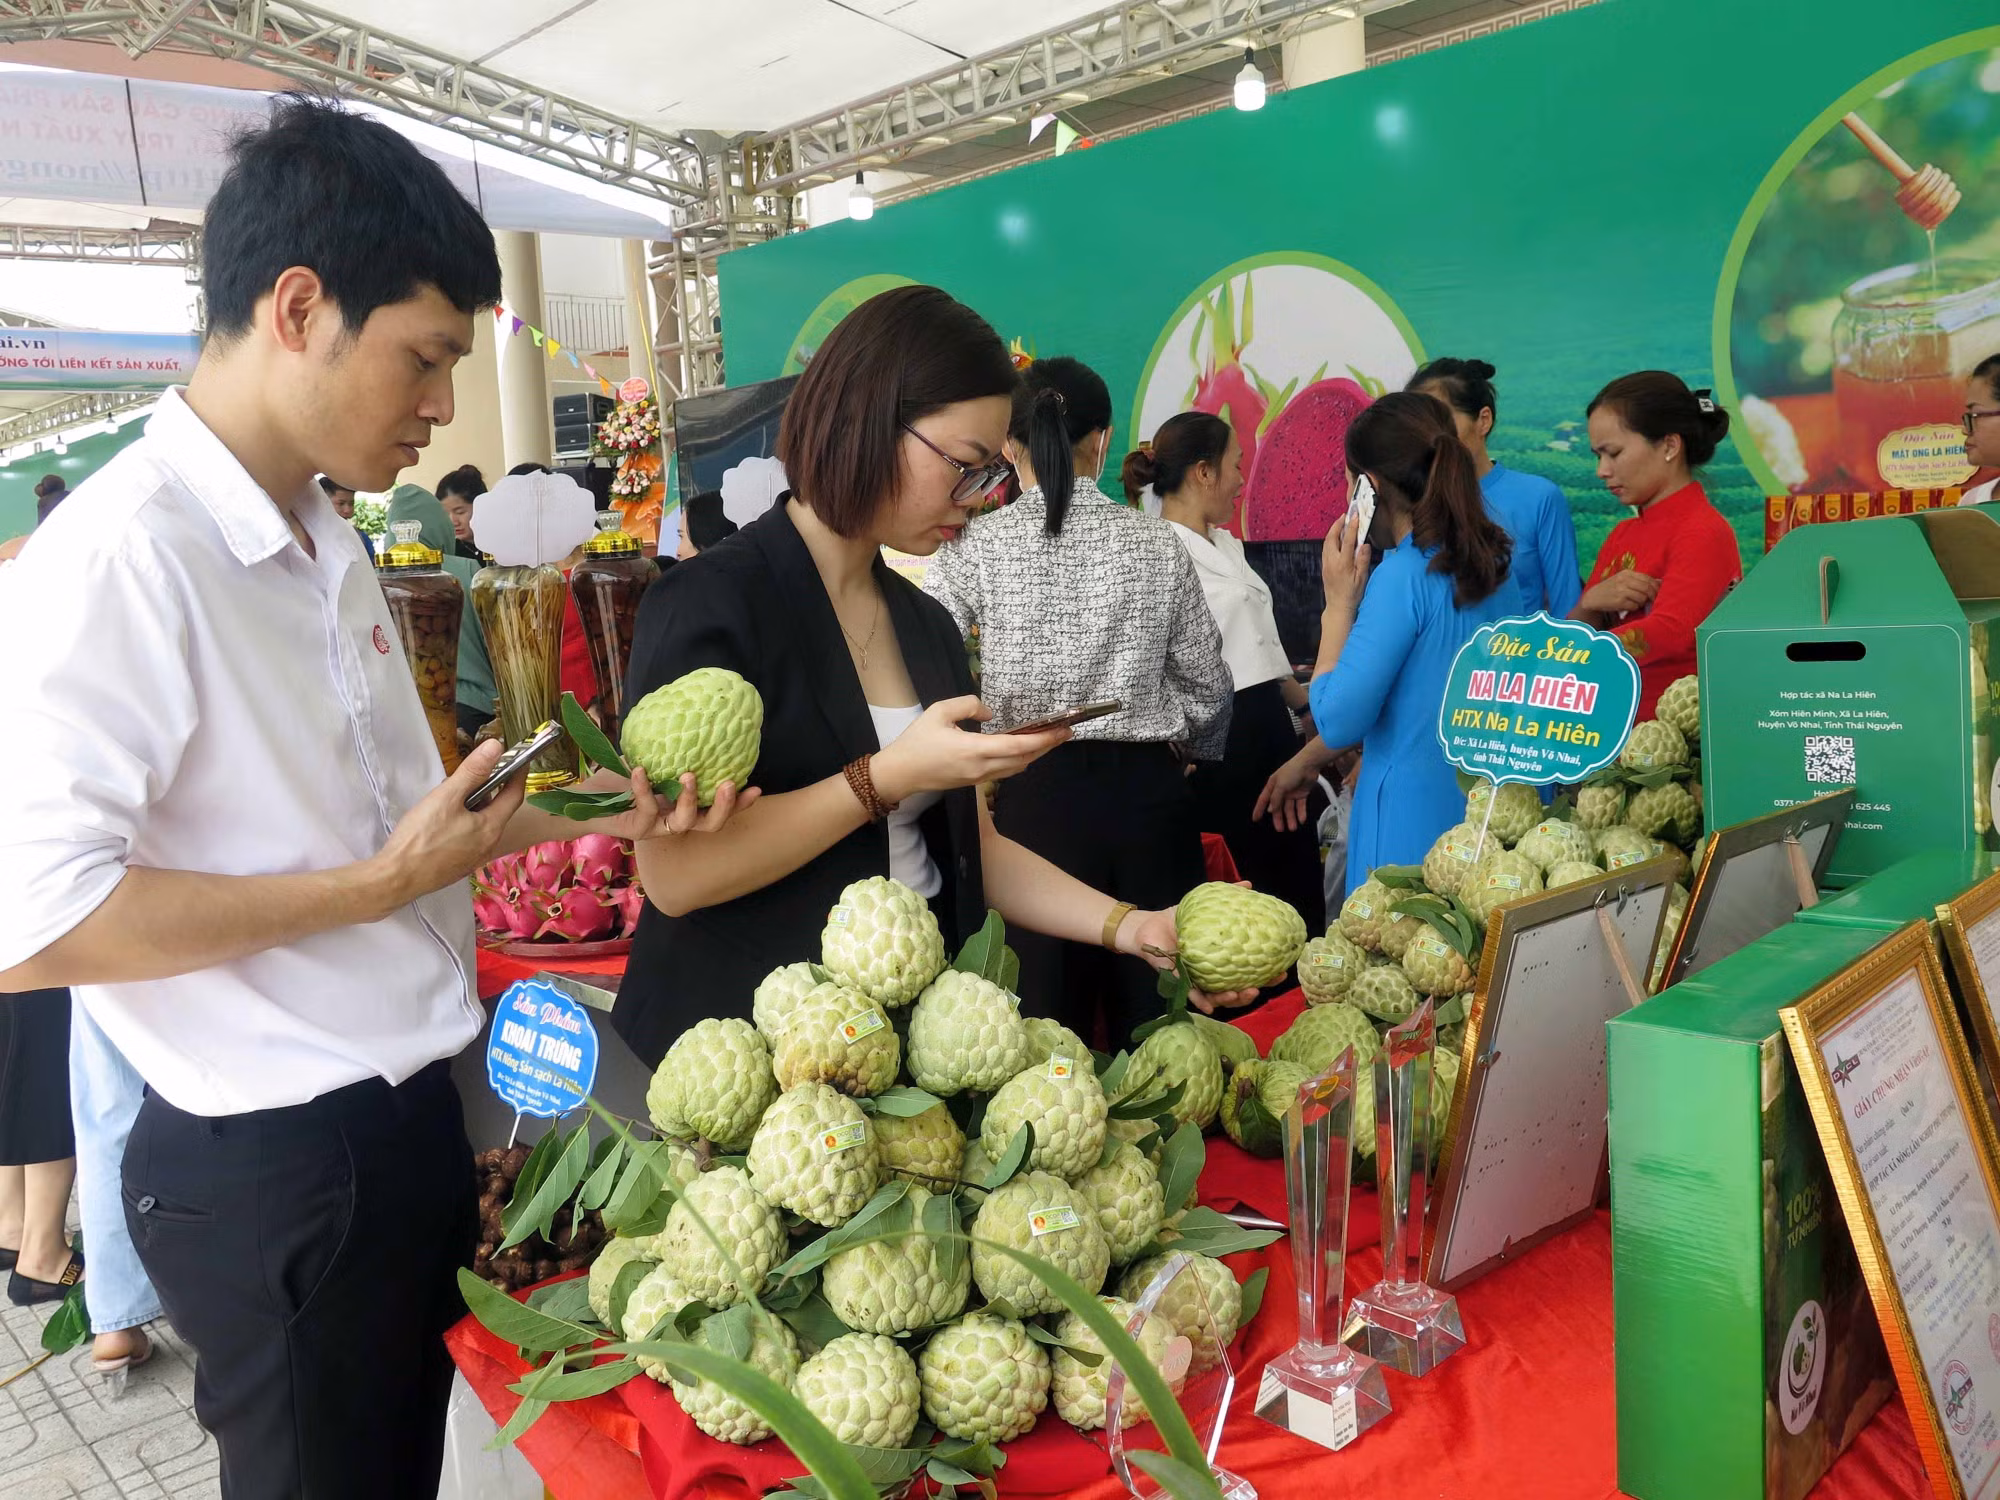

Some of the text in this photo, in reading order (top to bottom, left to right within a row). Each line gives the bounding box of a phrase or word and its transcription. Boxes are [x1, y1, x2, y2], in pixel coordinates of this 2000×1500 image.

[32, 356, 55, 368] TỚI
[59, 357, 86, 369] LIÊN
[91, 357, 112, 369] KẾT
[1932, 447, 1943, 456] LA
[1488, 633, 1590, 665] Đặc Sản
[1467, 670, 1599, 714] NA LA HIÊN
[1780, 690, 1876, 700] Hợp tác xã Na La Hiên
[1769, 709, 1789, 718] Xóm
[1813, 709, 1838, 719] Minh,
[1839, 709, 1851, 718] Xã
[1853, 710, 1864, 718] La
[1866, 710, 1889, 720] Hiên,
[1451, 709, 1601, 747] HTX Na La Hiên
[1758, 720, 1785, 731] Huyện
[1800, 720, 1823, 730] Nhai,
[1845, 720, 1865, 730] Thái
[1866, 721, 1903, 732] Nguyên
[1510, 743, 1539, 759] huyện
[1541, 748, 1555, 760] Võ
[1556, 751, 1582, 766] Nhai,
[1488, 753, 1506, 765] Thái
[1507, 756, 1543, 772] Nguyên
[1773, 799, 1794, 807] 0373
[1855, 803, 1872, 811] 625
[1873, 804, 1891, 812] 445
[500, 1019, 583, 1073] KHOAI TRỨNG
